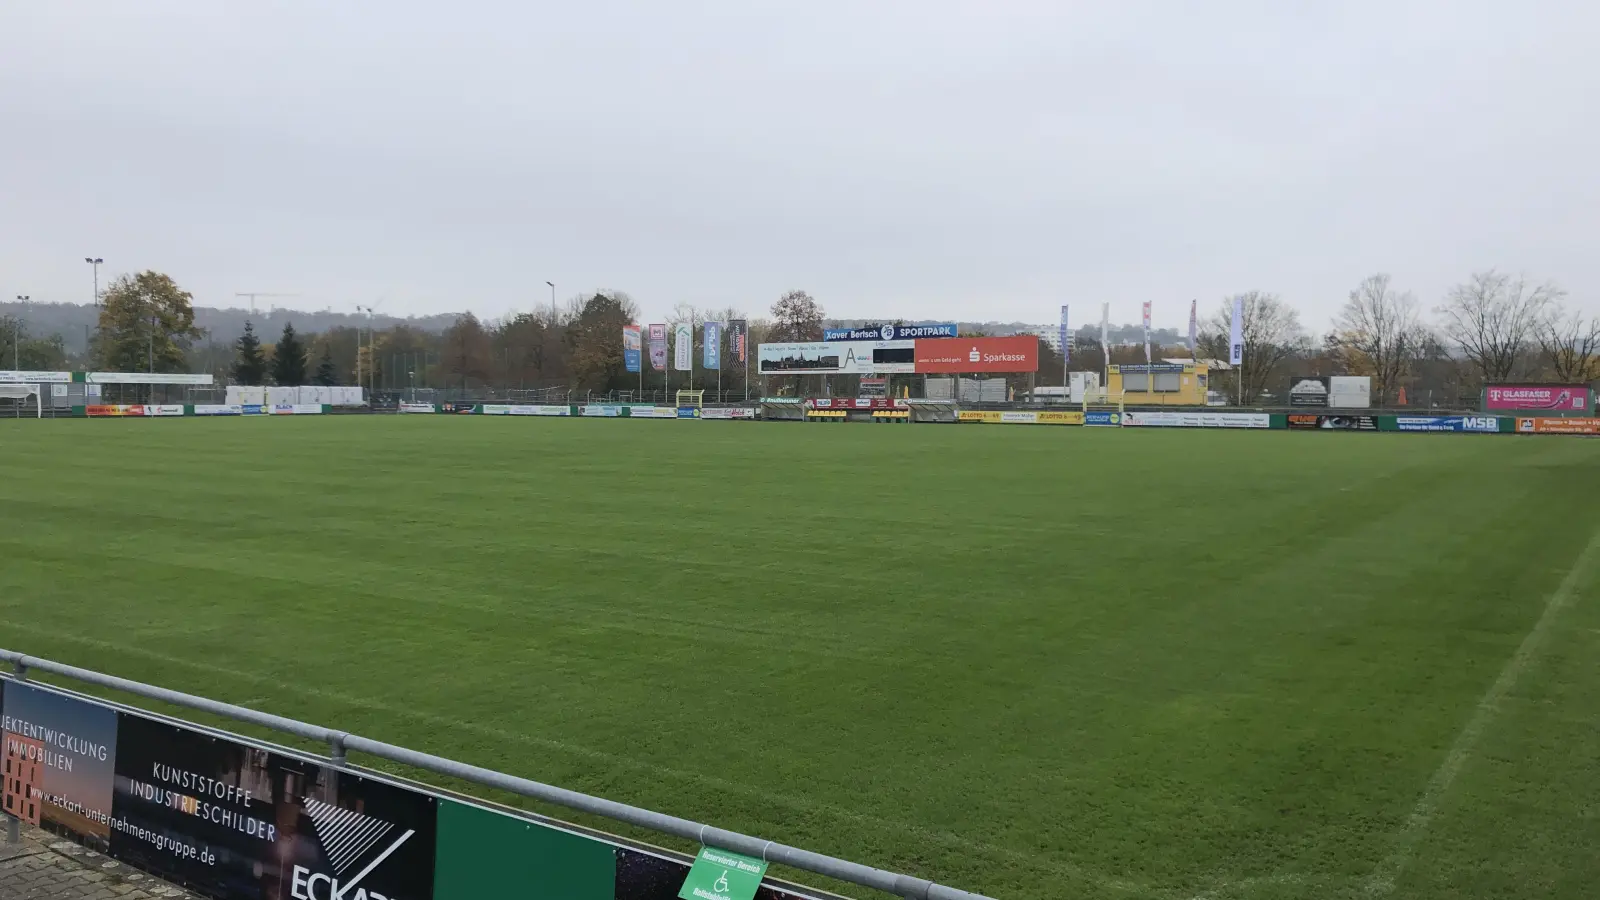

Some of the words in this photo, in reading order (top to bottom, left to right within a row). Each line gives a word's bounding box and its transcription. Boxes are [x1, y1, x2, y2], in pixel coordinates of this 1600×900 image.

[826, 331, 848, 340] Xaver
[850, 329, 878, 339] Bertsch
[899, 326, 951, 337] SPORTPARK
[983, 352, 1026, 363] Sparkasse
[1502, 390, 1551, 398] GLASFASER
[1463, 417, 1497, 429] MSB
[7, 737, 73, 773] IMMOBILIEN
[153, 761, 252, 808] KUNSTSTOFFE
[130, 779, 275, 843] INDUSTRIESCHILDER
[30, 786, 215, 866] www.eckart-unternehmensgruppe.de
[702, 851, 737, 867] Reservierter
[737, 860, 761, 874] Bereich
